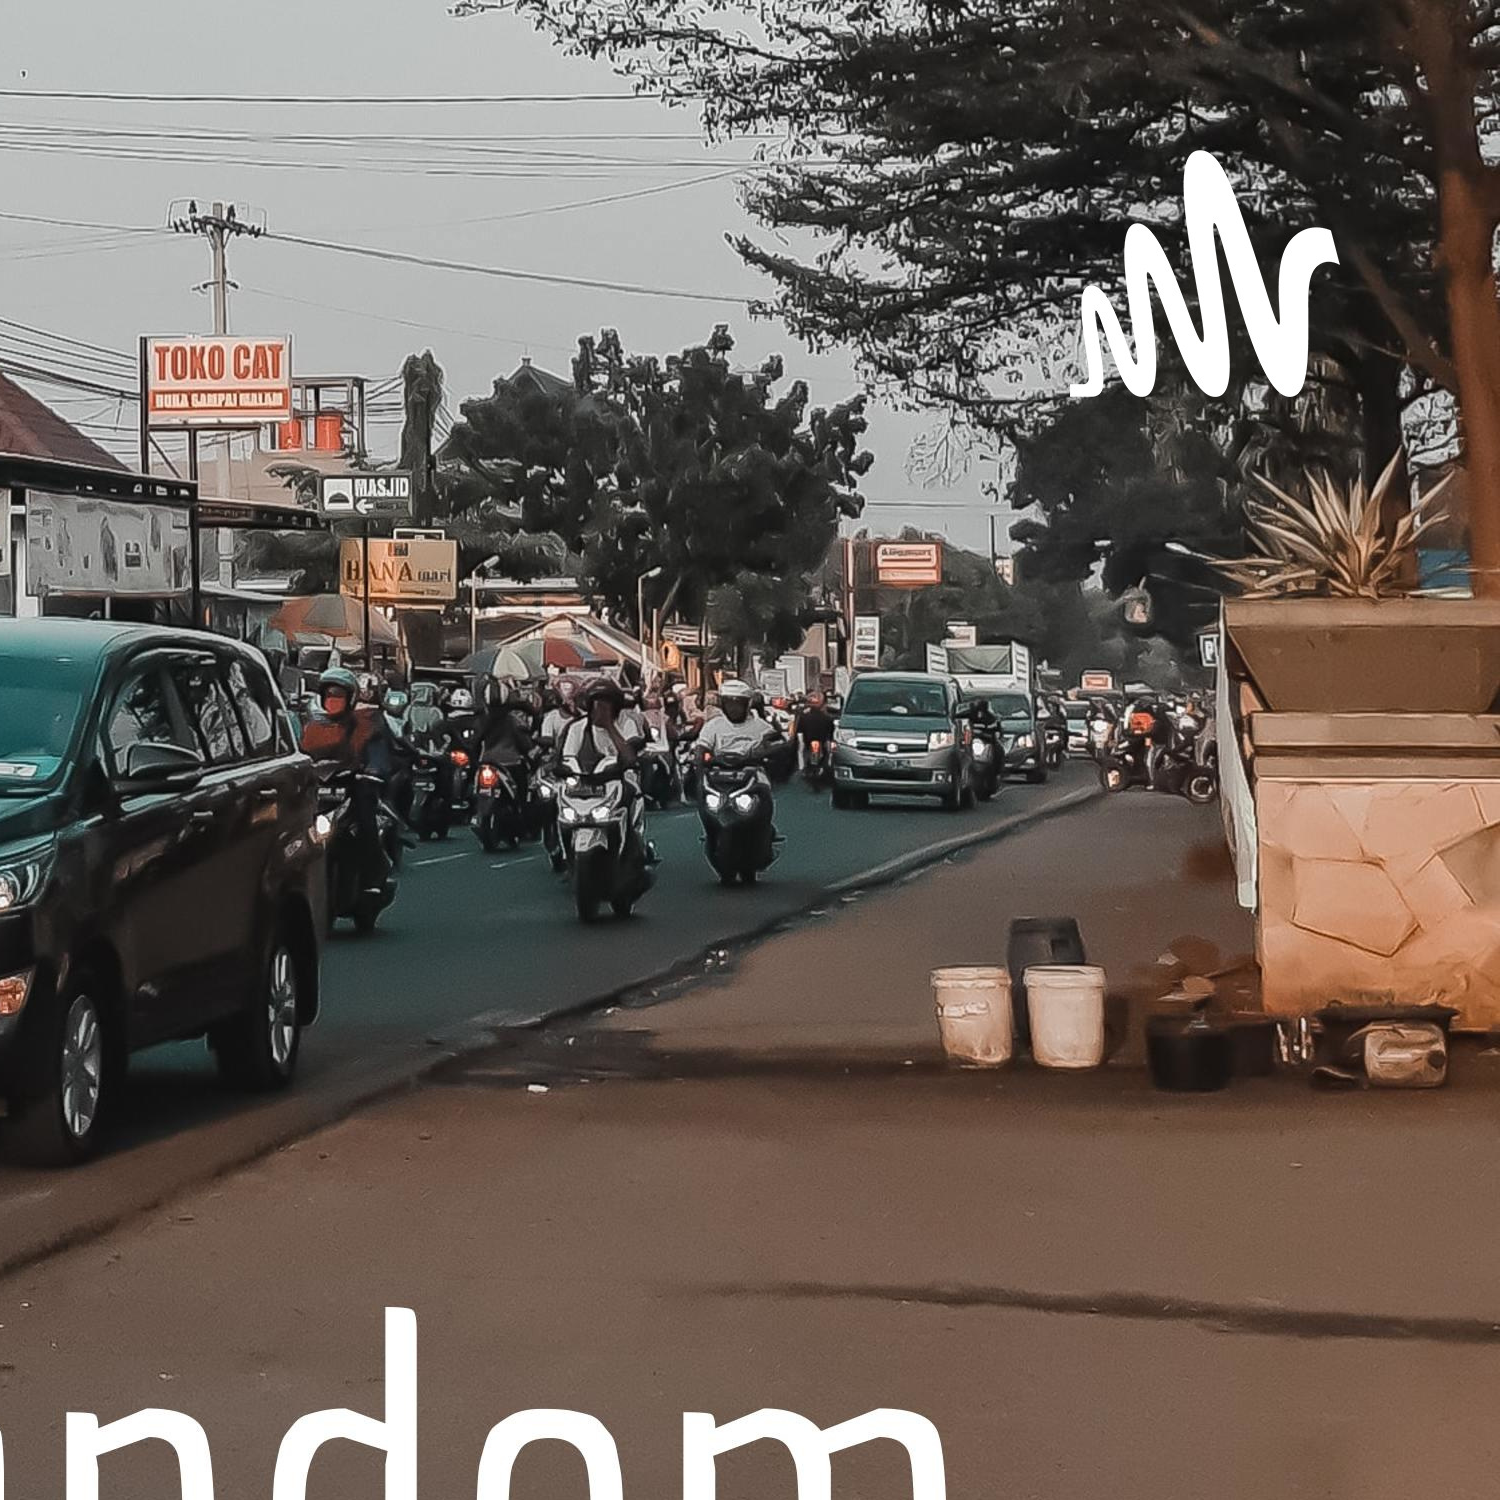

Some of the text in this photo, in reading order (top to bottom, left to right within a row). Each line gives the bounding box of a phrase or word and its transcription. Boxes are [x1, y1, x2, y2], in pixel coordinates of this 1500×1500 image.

[154, 344, 284, 380] TOKO CAT
[191, 392, 237, 408] SAMPAI
[355, 477, 409, 497] MASJID
